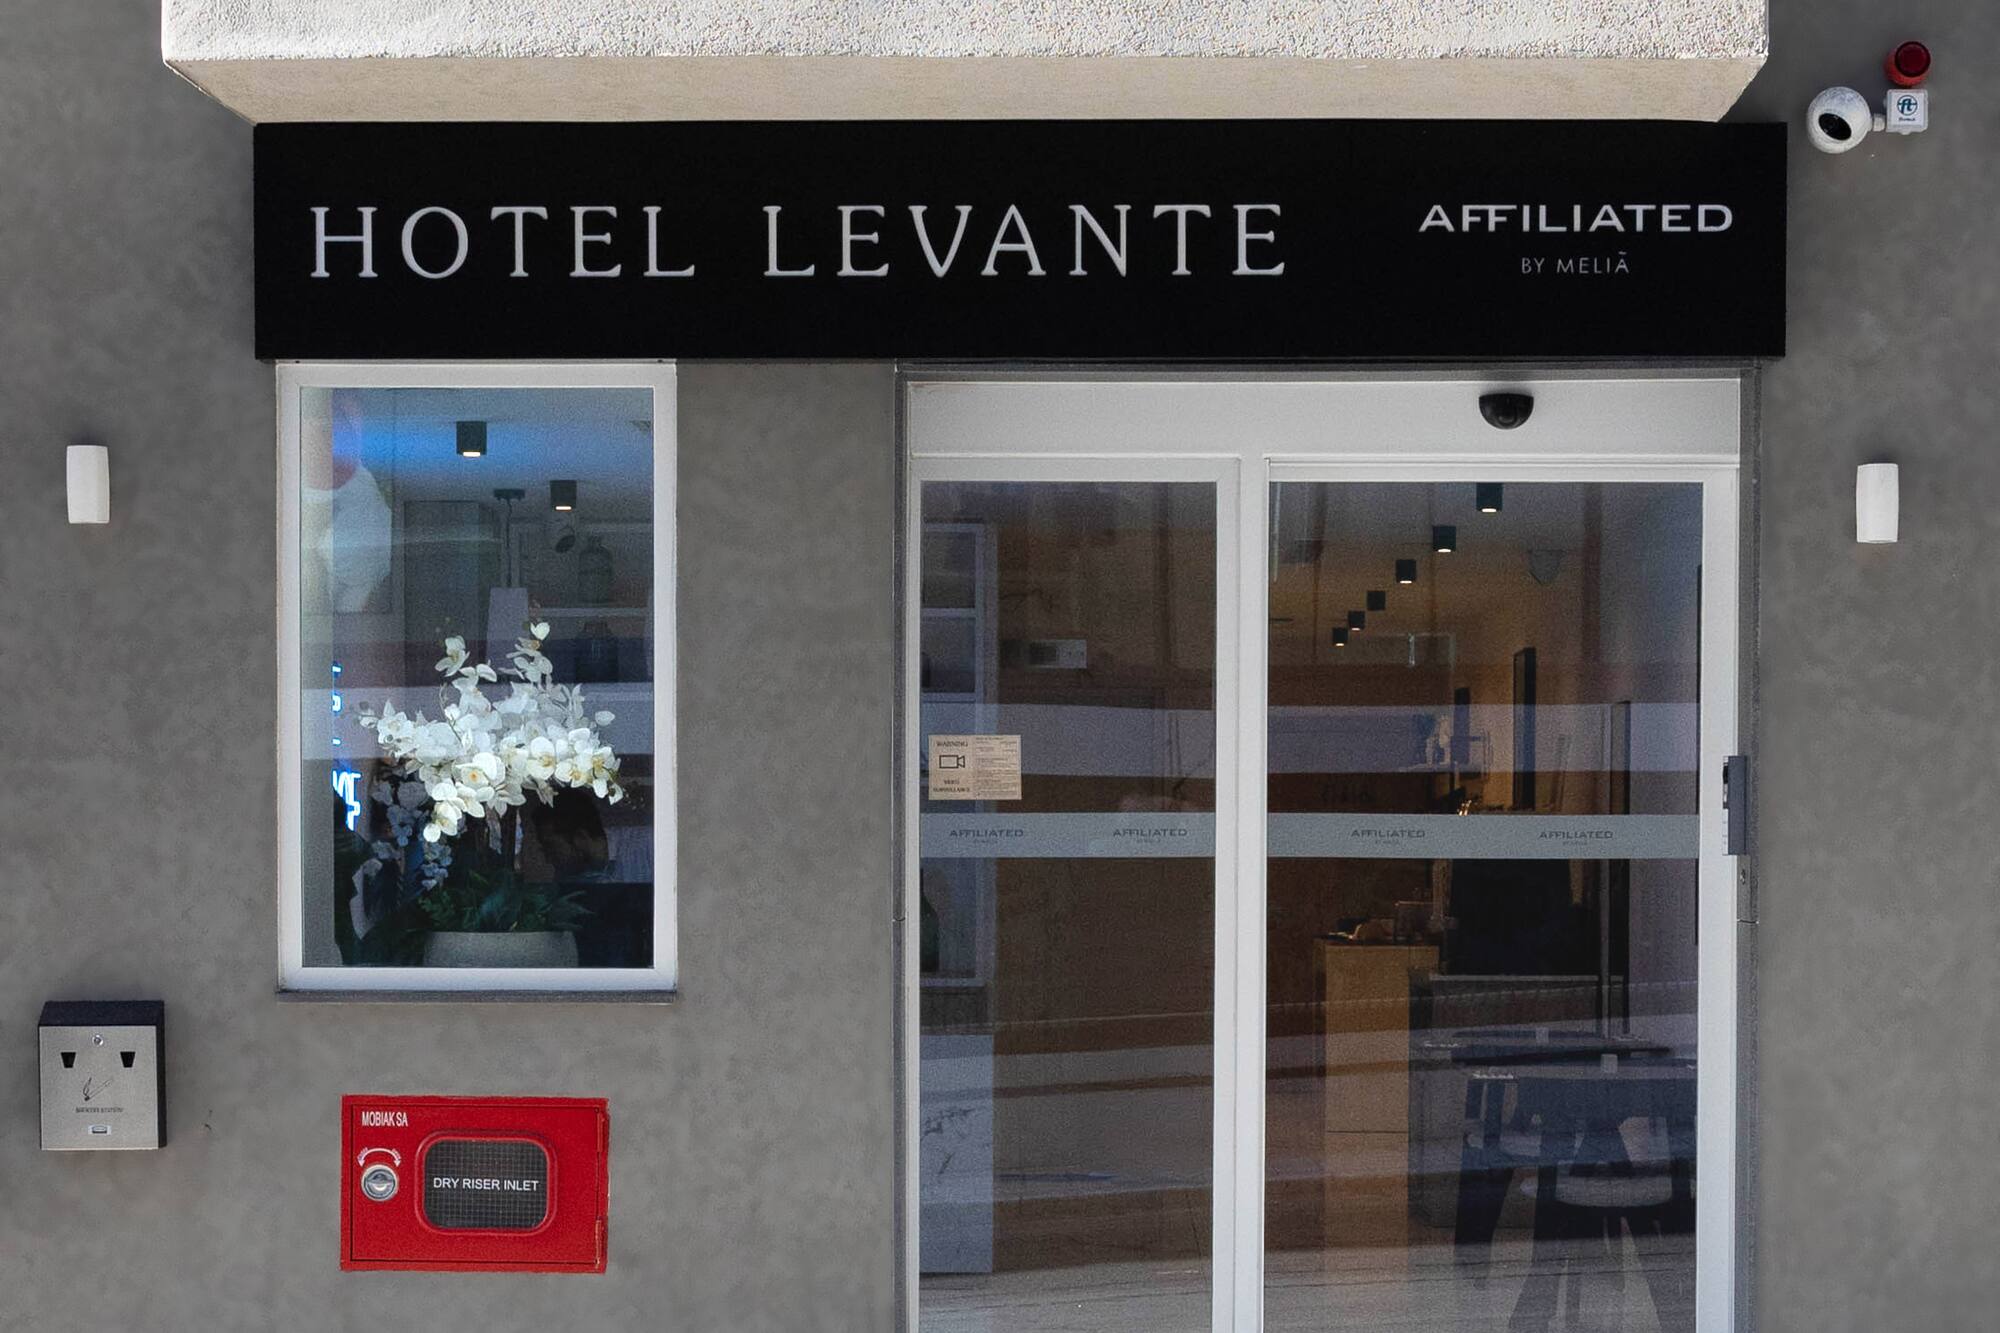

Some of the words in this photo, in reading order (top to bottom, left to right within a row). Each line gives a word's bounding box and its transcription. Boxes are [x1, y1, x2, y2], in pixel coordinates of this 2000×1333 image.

[1418, 203, 1734, 233] AFFILIATED
[310, 204, 696, 280] HOTEL
[762, 202, 1286, 279] LEVANTE
[1521, 257, 1545, 274] BY
[949, 828, 1024, 838] AFFILIATED
[1112, 828, 1188, 837] AFFILIATED
[1350, 829, 1426, 838] AFFILIATED
[1538, 830, 1614, 839] AFFILIATED
[361, 1111, 395, 1127] MOBIAK
[396, 1112, 409, 1127] SA
[433, 1177, 460, 1190] DRY
[462, 1178, 501, 1191] RISER
[503, 1179, 540, 1192] INLET
